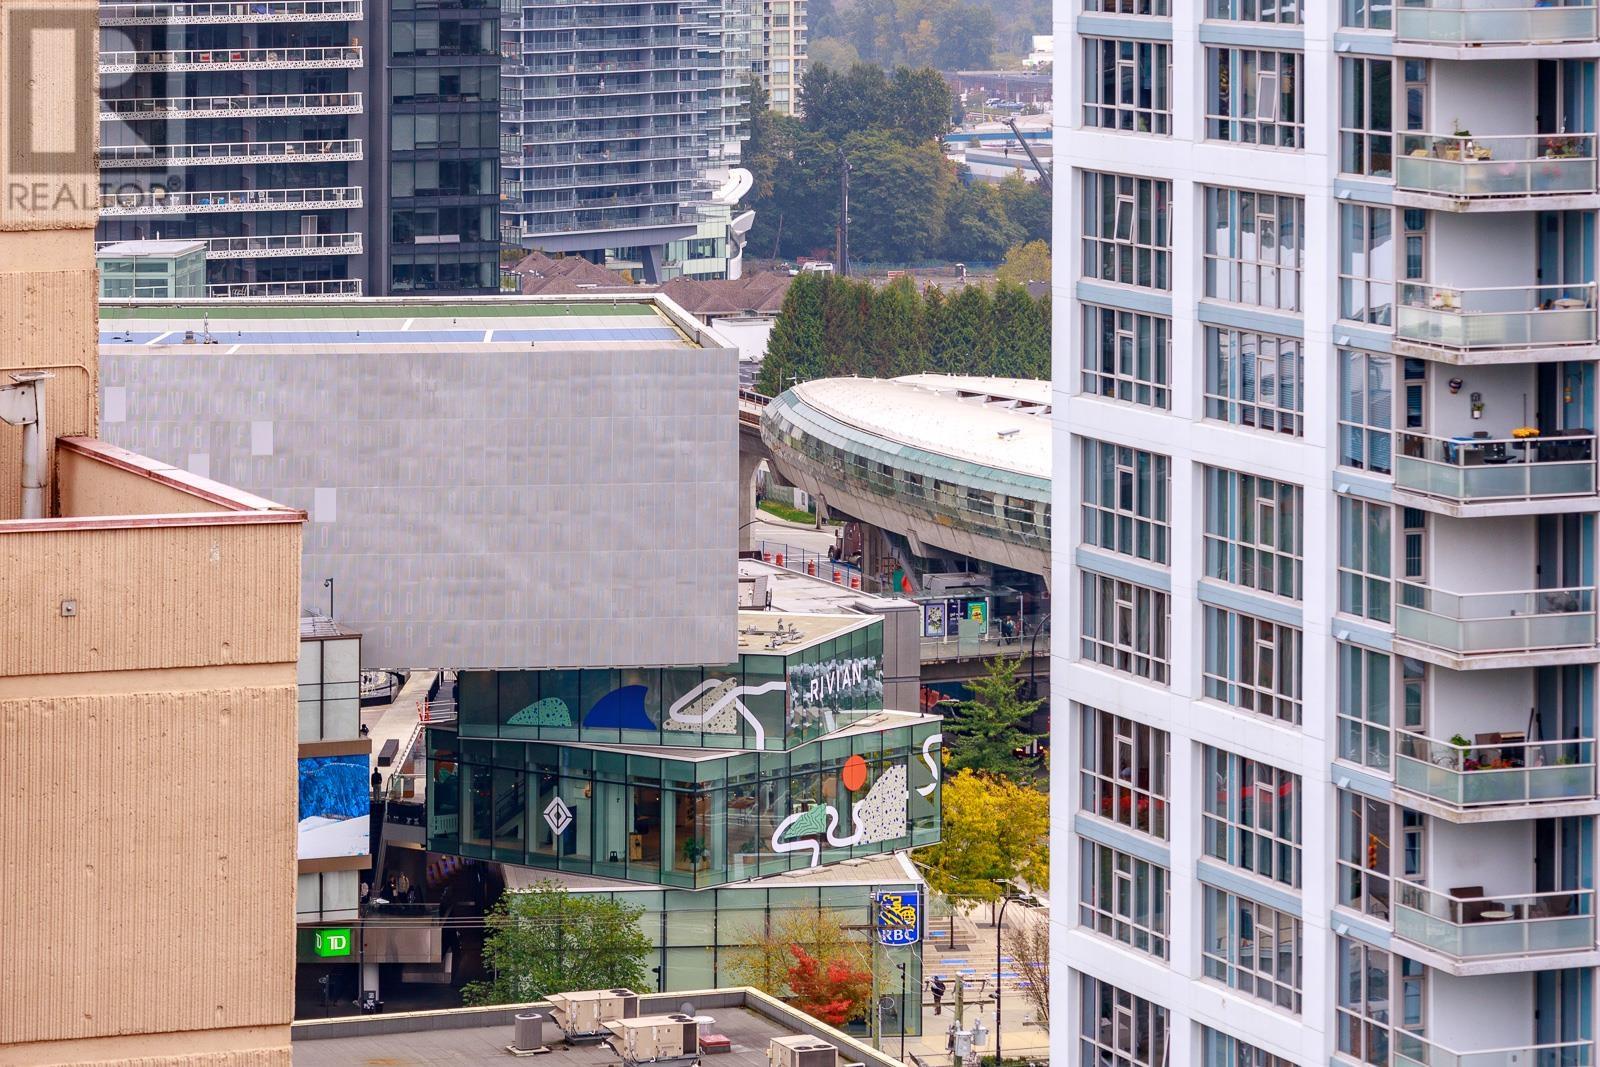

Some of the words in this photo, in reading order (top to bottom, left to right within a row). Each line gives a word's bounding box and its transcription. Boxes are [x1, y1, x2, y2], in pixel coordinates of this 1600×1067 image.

[809, 660, 862, 702] RIVIAN
[326, 935, 347, 950] TD
[882, 929, 914, 941] RBC
